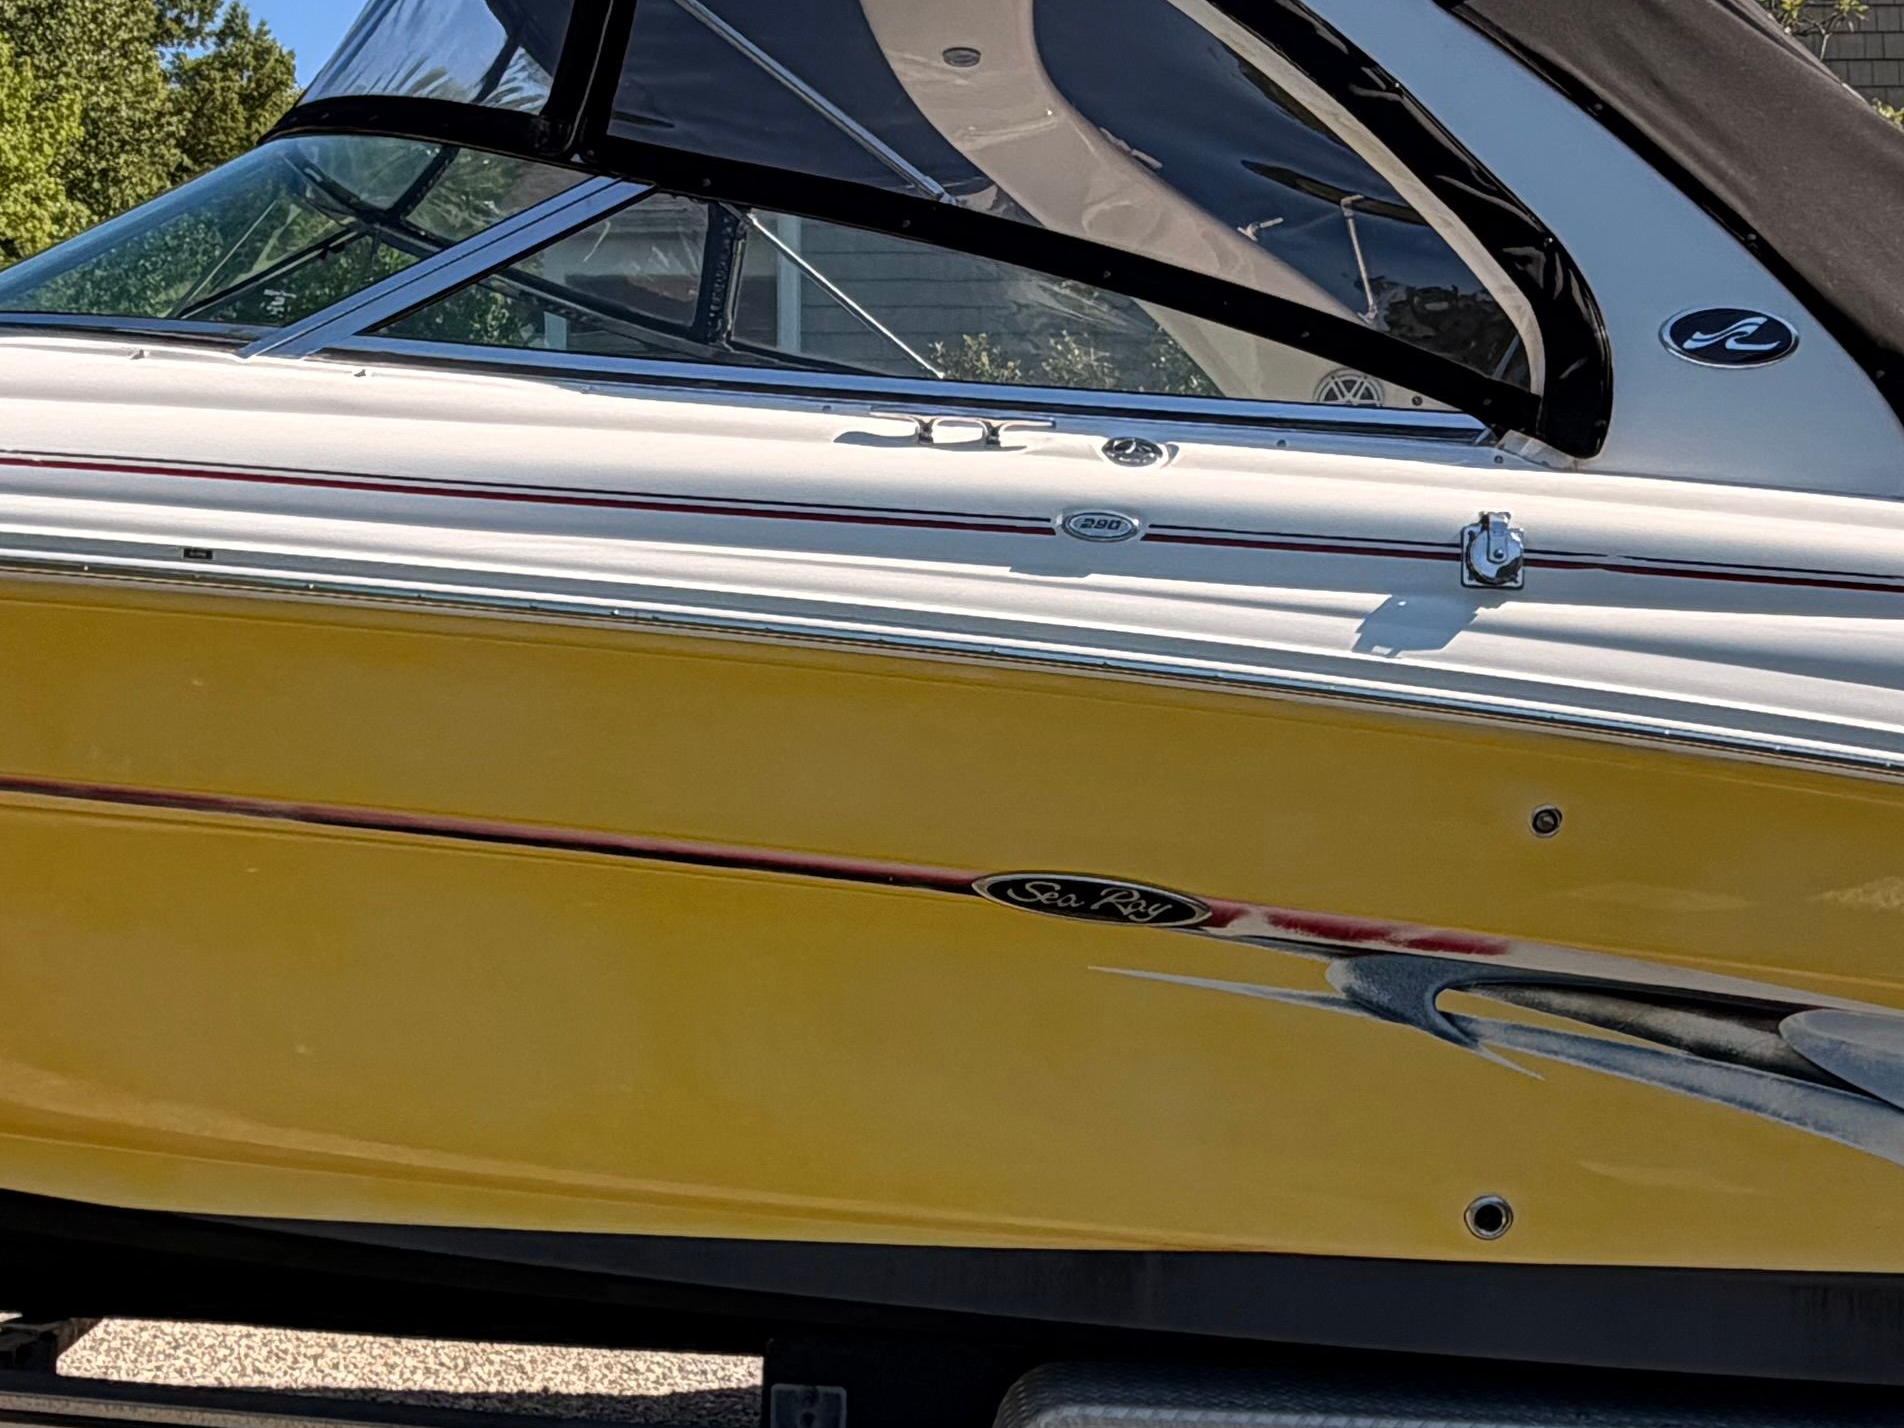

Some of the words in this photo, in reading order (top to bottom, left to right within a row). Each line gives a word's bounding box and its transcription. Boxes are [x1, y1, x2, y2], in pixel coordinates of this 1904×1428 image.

[1079, 518, 1122, 531] 290
[1006, 881, 1085, 908] Sea
[1090, 887, 1173, 922] Ray
